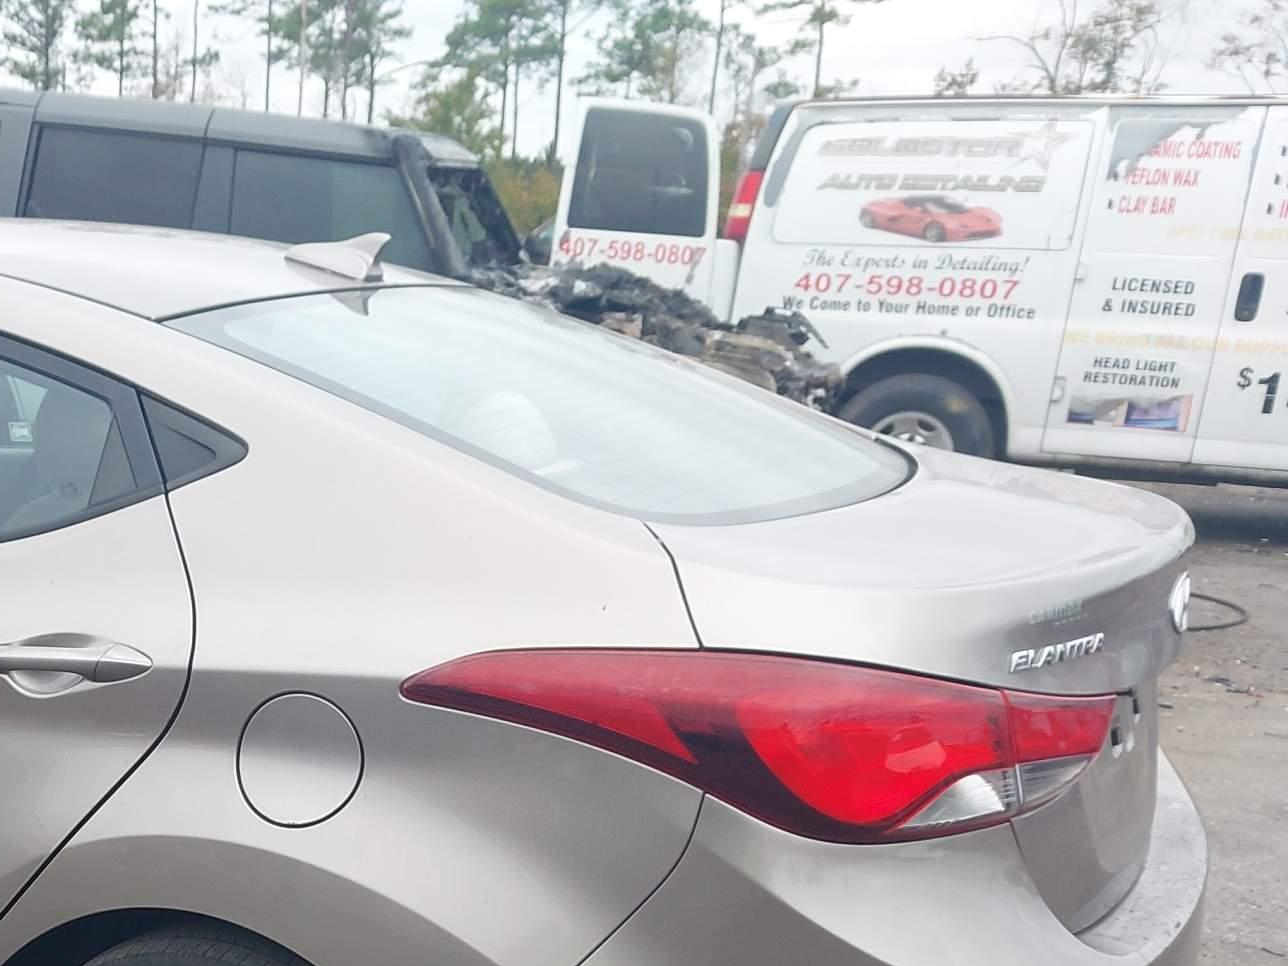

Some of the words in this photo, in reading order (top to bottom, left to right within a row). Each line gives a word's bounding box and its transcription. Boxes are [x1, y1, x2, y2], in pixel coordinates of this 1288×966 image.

[1187, 140, 1241, 158] COATING
[817, 173, 899, 191] AUTO
[899, 174, 1047, 192] DETAILING
[1173, 168, 1201, 186] WAX
[1118, 195, 1150, 213] CLAY
[1151, 196, 1176, 214] BAR
[559, 236, 706, 265] 407-598-0807
[802, 249, 833, 267] The
[840, 250, 906, 272] Experts
[912, 257, 928, 270] in
[934, 252, 1030, 275] Detailing!
[794, 271, 1021, 300] 407-598-0807
[1111, 276, 1195, 295] LICENSED
[781, 295, 803, 310] We
[812, 297, 850, 311] Come
[856, 299, 871, 312] to
[878, 299, 909, 314] Your
[915, 301, 959, 316] Home
[965, 305, 980, 317] or
[987, 303, 1037, 319] Office
[1102, 298, 1113, 313] &
[1120, 300, 1196, 317] INSURED
[1092, 356, 1130, 370] HEAD
[1134, 358, 1177, 373] LIGHT
[1082, 371, 1180, 388] RESTORATION
[1237, 366, 1288, 415] $1
[1009, 632, 1104, 673] ELANTRA
